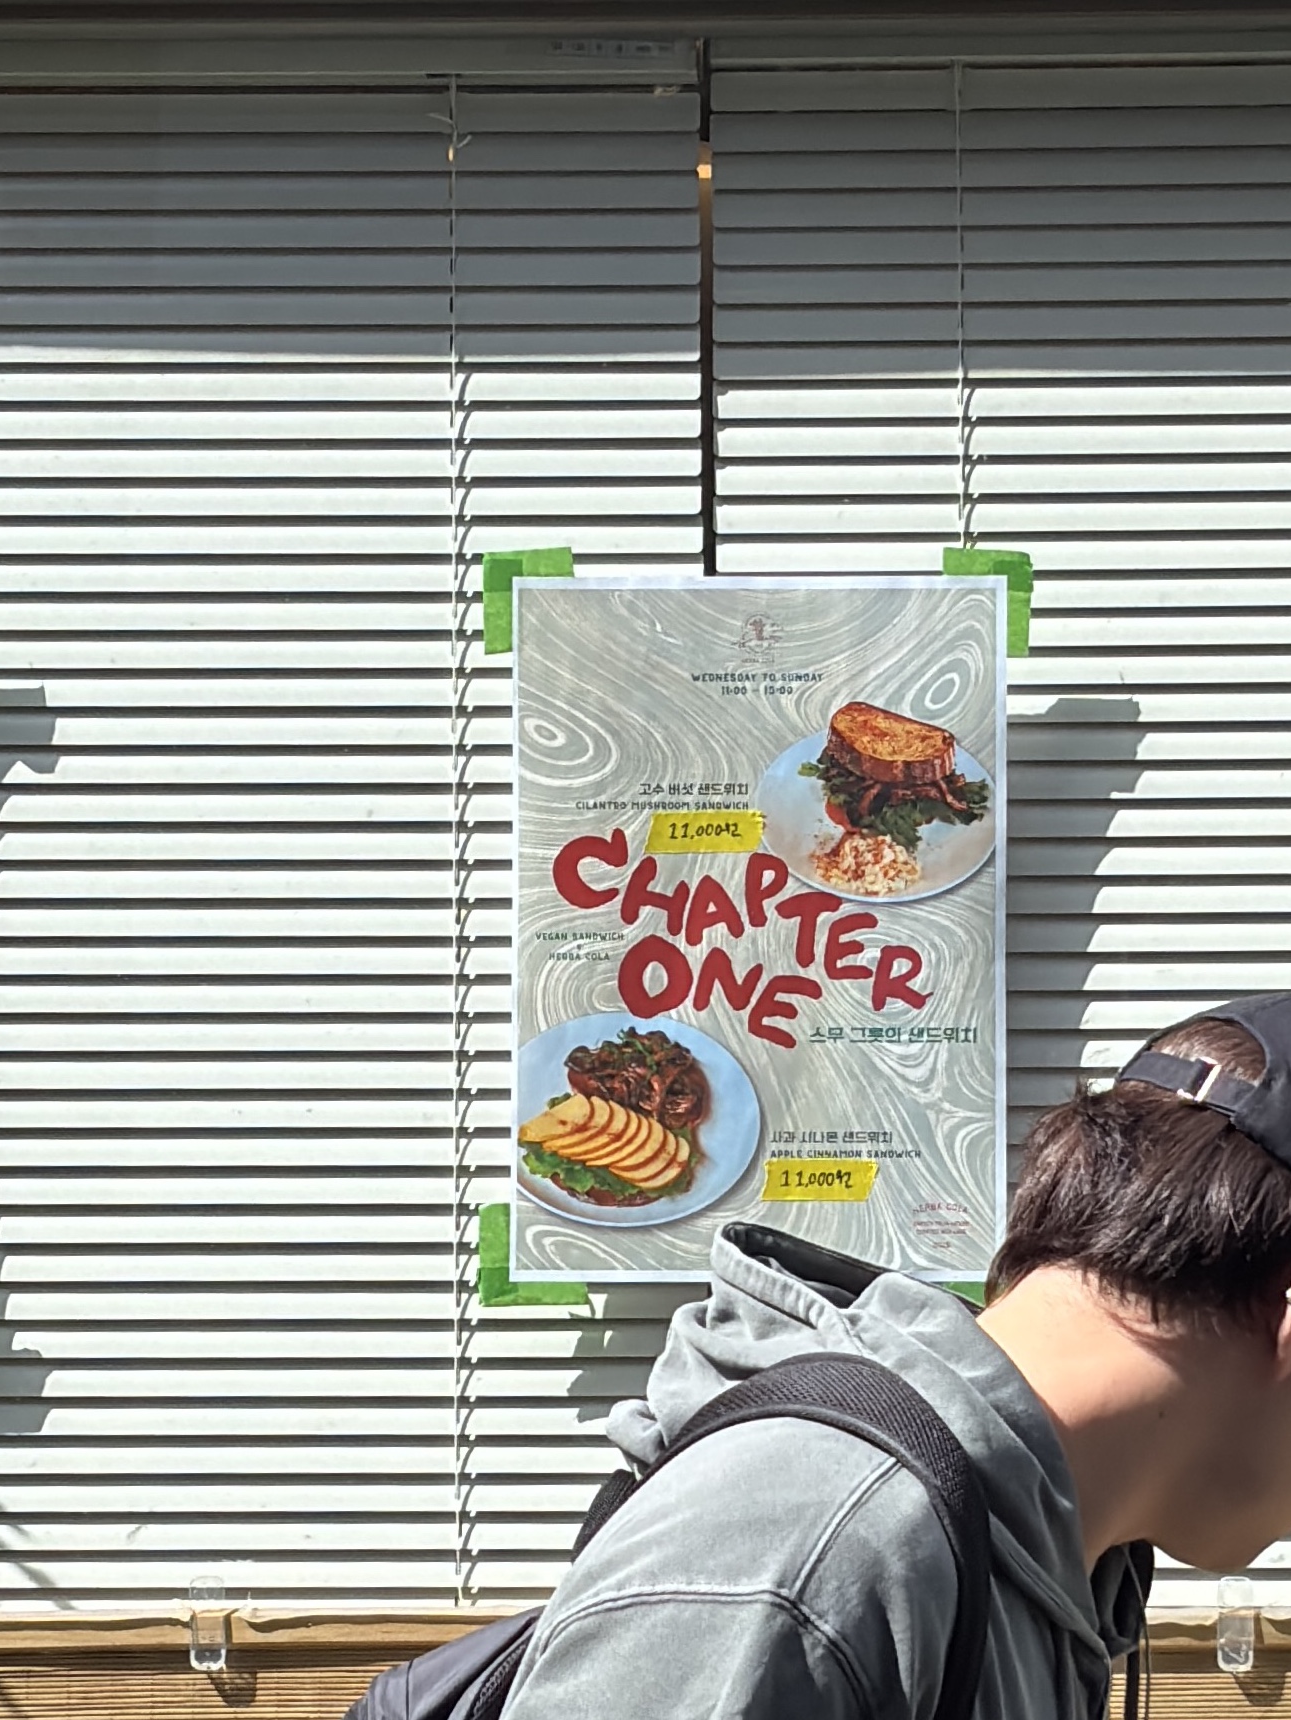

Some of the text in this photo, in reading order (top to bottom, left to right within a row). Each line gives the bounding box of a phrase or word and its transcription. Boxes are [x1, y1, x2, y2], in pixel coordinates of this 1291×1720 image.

[691, 673, 824, 683] WEDNESDAY TO SUNDAY
[639, 784, 749, 796] 고수 버섯 샌드위치
[576, 801, 749, 811] CILANTRO MUSHROOM SANDWICH
[553, 828, 933, 1011] CHAPTER
[535, 932, 625, 941] VEGAN SANDWICH
[585, 953, 610, 961] COLA
[618, 935, 823, 1049] ONE
[809, 1027, 844, 1043] 스무
[908, 1027, 977, 1043] 샌드위치
[771, 1132, 893, 1144] 사과 시나몬 샌드위치
[770, 1150, 921, 1159] APPLE CINNAMON SANDWICH
